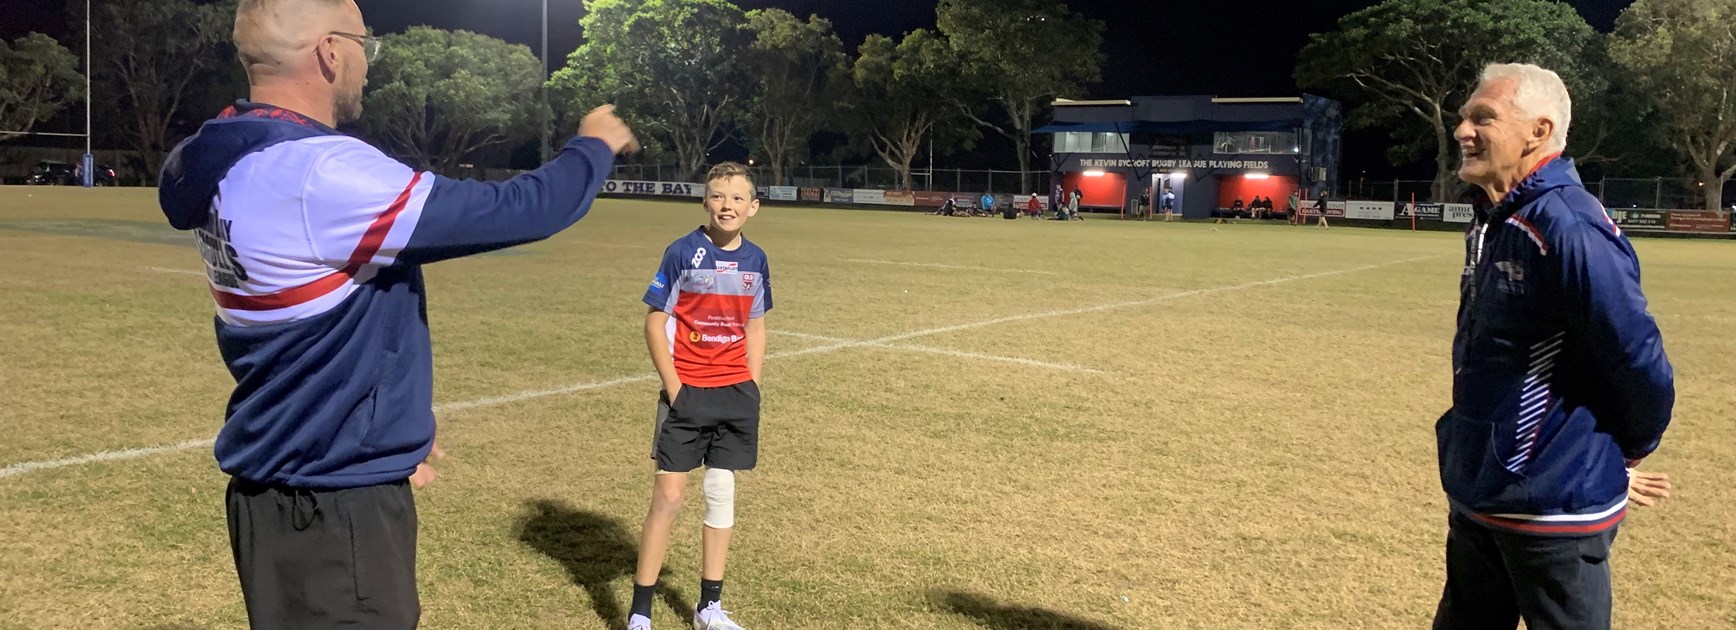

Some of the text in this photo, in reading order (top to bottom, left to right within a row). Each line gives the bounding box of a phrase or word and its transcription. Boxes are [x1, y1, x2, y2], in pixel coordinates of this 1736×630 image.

[1094, 159, 1117, 167] KEVIN
[1151, 159, 1177, 168] RUGBY
[1178, 160, 1207, 168] LEAGUE
[1208, 160, 1243, 168] PLAYING
[1243, 161, 1269, 169] FIELDS
[601, 181, 692, 195] O THE BAY
[702, 334, 730, 344] Bendigo
